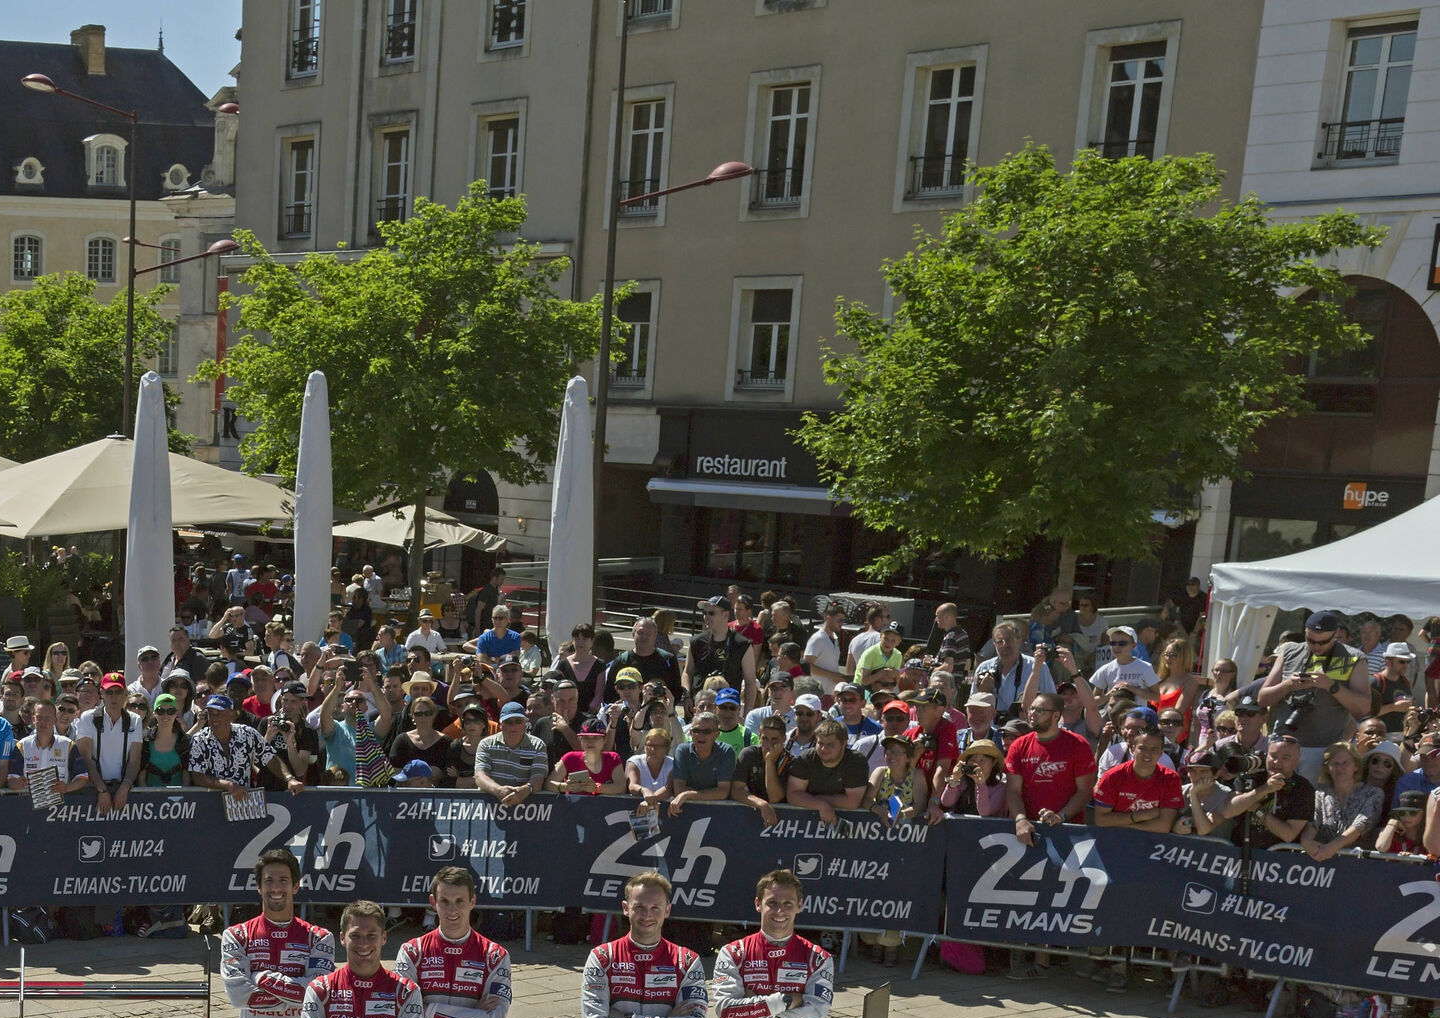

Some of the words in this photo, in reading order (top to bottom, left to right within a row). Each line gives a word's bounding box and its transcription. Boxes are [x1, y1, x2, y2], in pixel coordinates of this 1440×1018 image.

[696, 454, 787, 478] restaurant
[1343, 484, 1389, 507] hype
[46, 801, 196, 823] 24H-LEMANS.COM
[396, 802, 552, 822] 24H-LEMANS.COM
[232, 802, 366, 871] 24h
[589, 808, 727, 886] 24h
[109, 839, 165, 858] #LM24
[459, 840, 518, 858] #LM24
[826, 858, 889, 881] #LM24
[968, 832, 1109, 910] 24h
[53, 874, 187, 895] LEMANS-TV.COM
[298, 874, 357, 892] ANS
[401, 875, 541, 895] LEM-TV.COM
[583, 877, 620, 898] LE
[800, 895, 913, 920] ANS-TV.COM
[1220, 894, 1289, 923] #LM24
[963, 907, 1000, 929] LE
[1005, 910, 1096, 935] MANS
[1146, 917, 1315, 968] LEMANS-TV.COM
[278, 966, 301, 974] Sport
[612, 962, 635, 970] ORIS
[1365, 955, 1416, 981] LE
[452, 984, 477, 992] Sport
[645, 990, 671, 998] Sport
[775, 984, 800, 992] Sport
